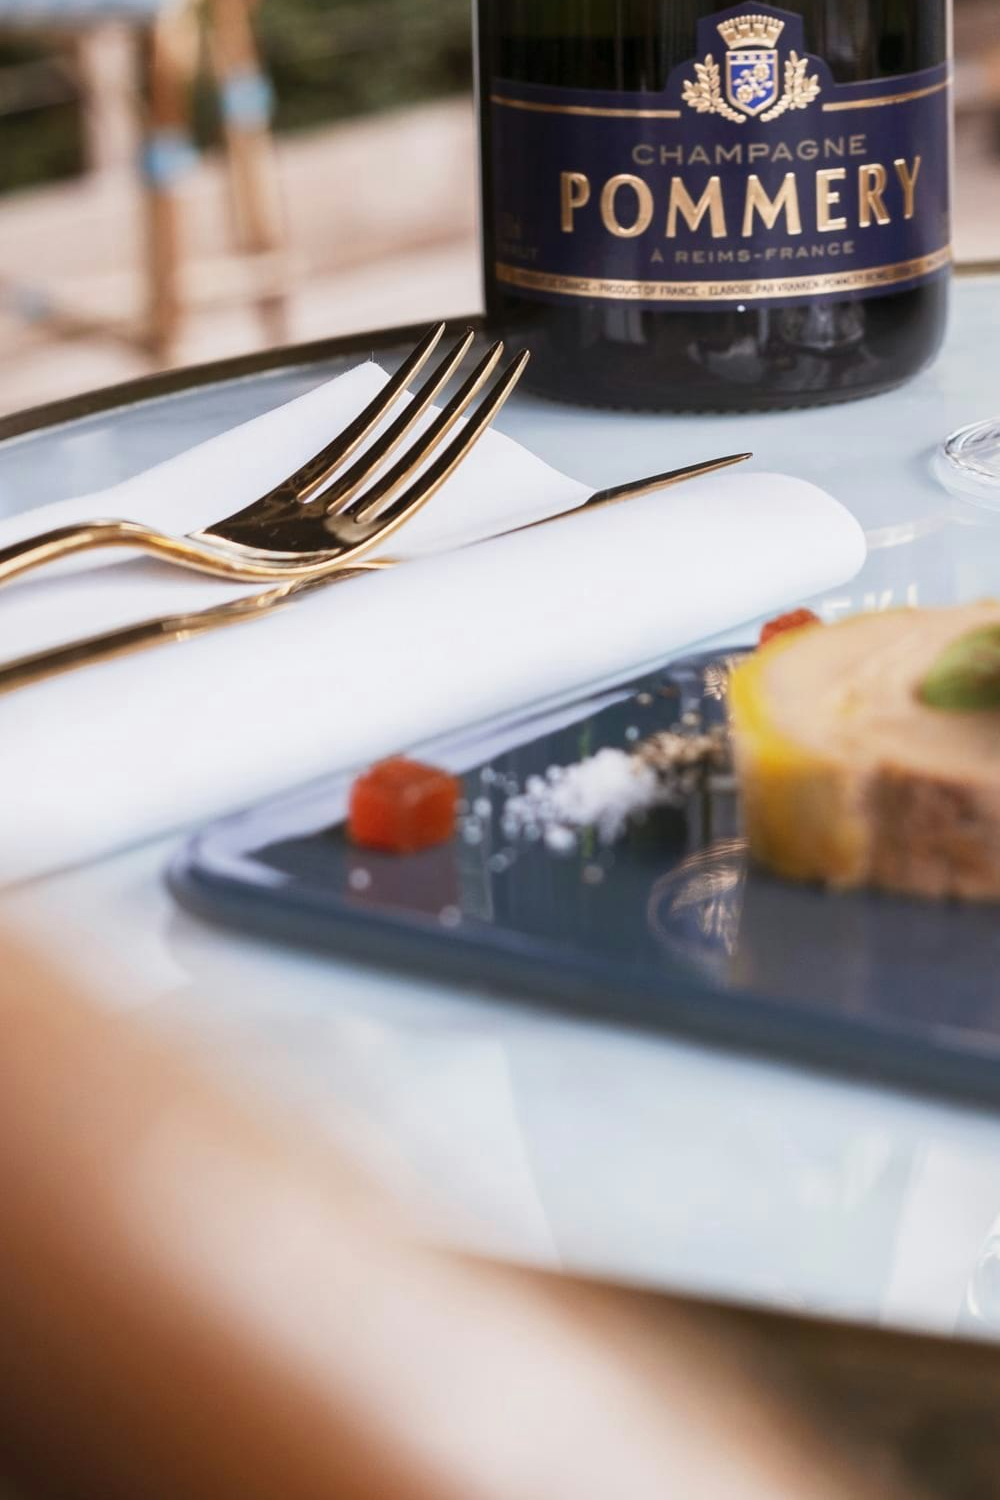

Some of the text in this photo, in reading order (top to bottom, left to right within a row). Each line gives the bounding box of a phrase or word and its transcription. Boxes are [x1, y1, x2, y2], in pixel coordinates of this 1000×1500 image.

[631, 134, 867, 165] CHAMPAGNE
[560, 155, 921, 238] POMMERY
[675, 240, 856, 264] REIMS-FRANCE
